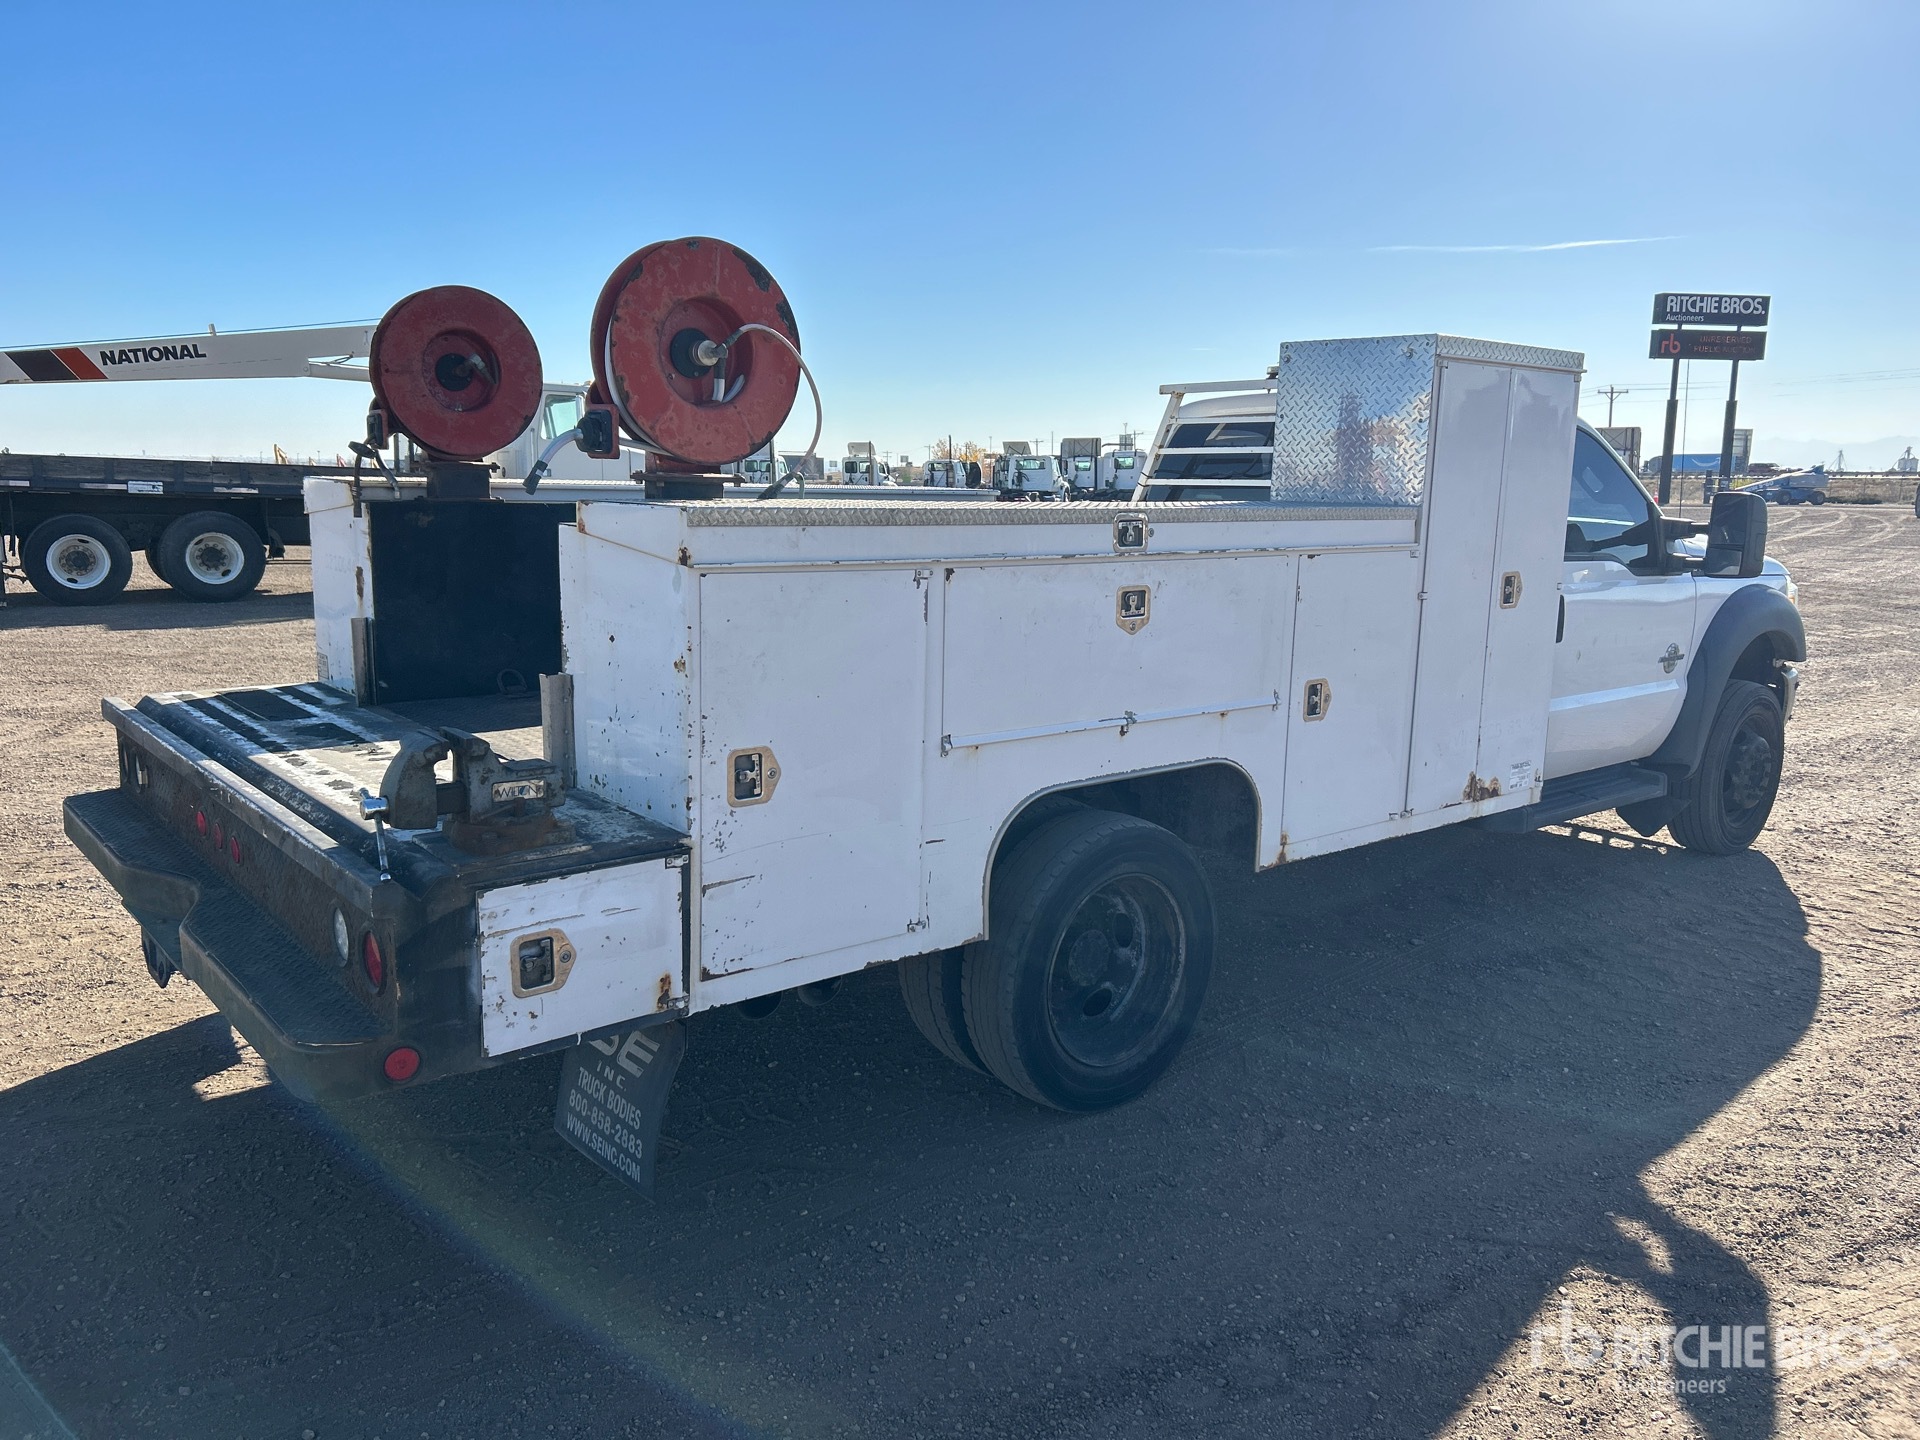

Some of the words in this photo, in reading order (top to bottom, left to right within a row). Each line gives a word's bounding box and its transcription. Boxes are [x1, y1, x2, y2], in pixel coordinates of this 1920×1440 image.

[1666, 295, 1719, 314] RITCHIE
[1720, 297, 1766, 315] BROS.
[1665, 313, 1705, 322] Auctioneers
[1660, 333, 1681, 354] rb
[1700, 335, 1752, 344] UNRESERVED
[99, 343, 207, 366] NATIONAL
[578, 1066, 605, 1105] TRUCK
[606, 1088, 642, 1130] BODIES
[569, 1088, 643, 1160] 800-858-2883
[566, 1111, 641, 1183] WWW.SEINC.COM
